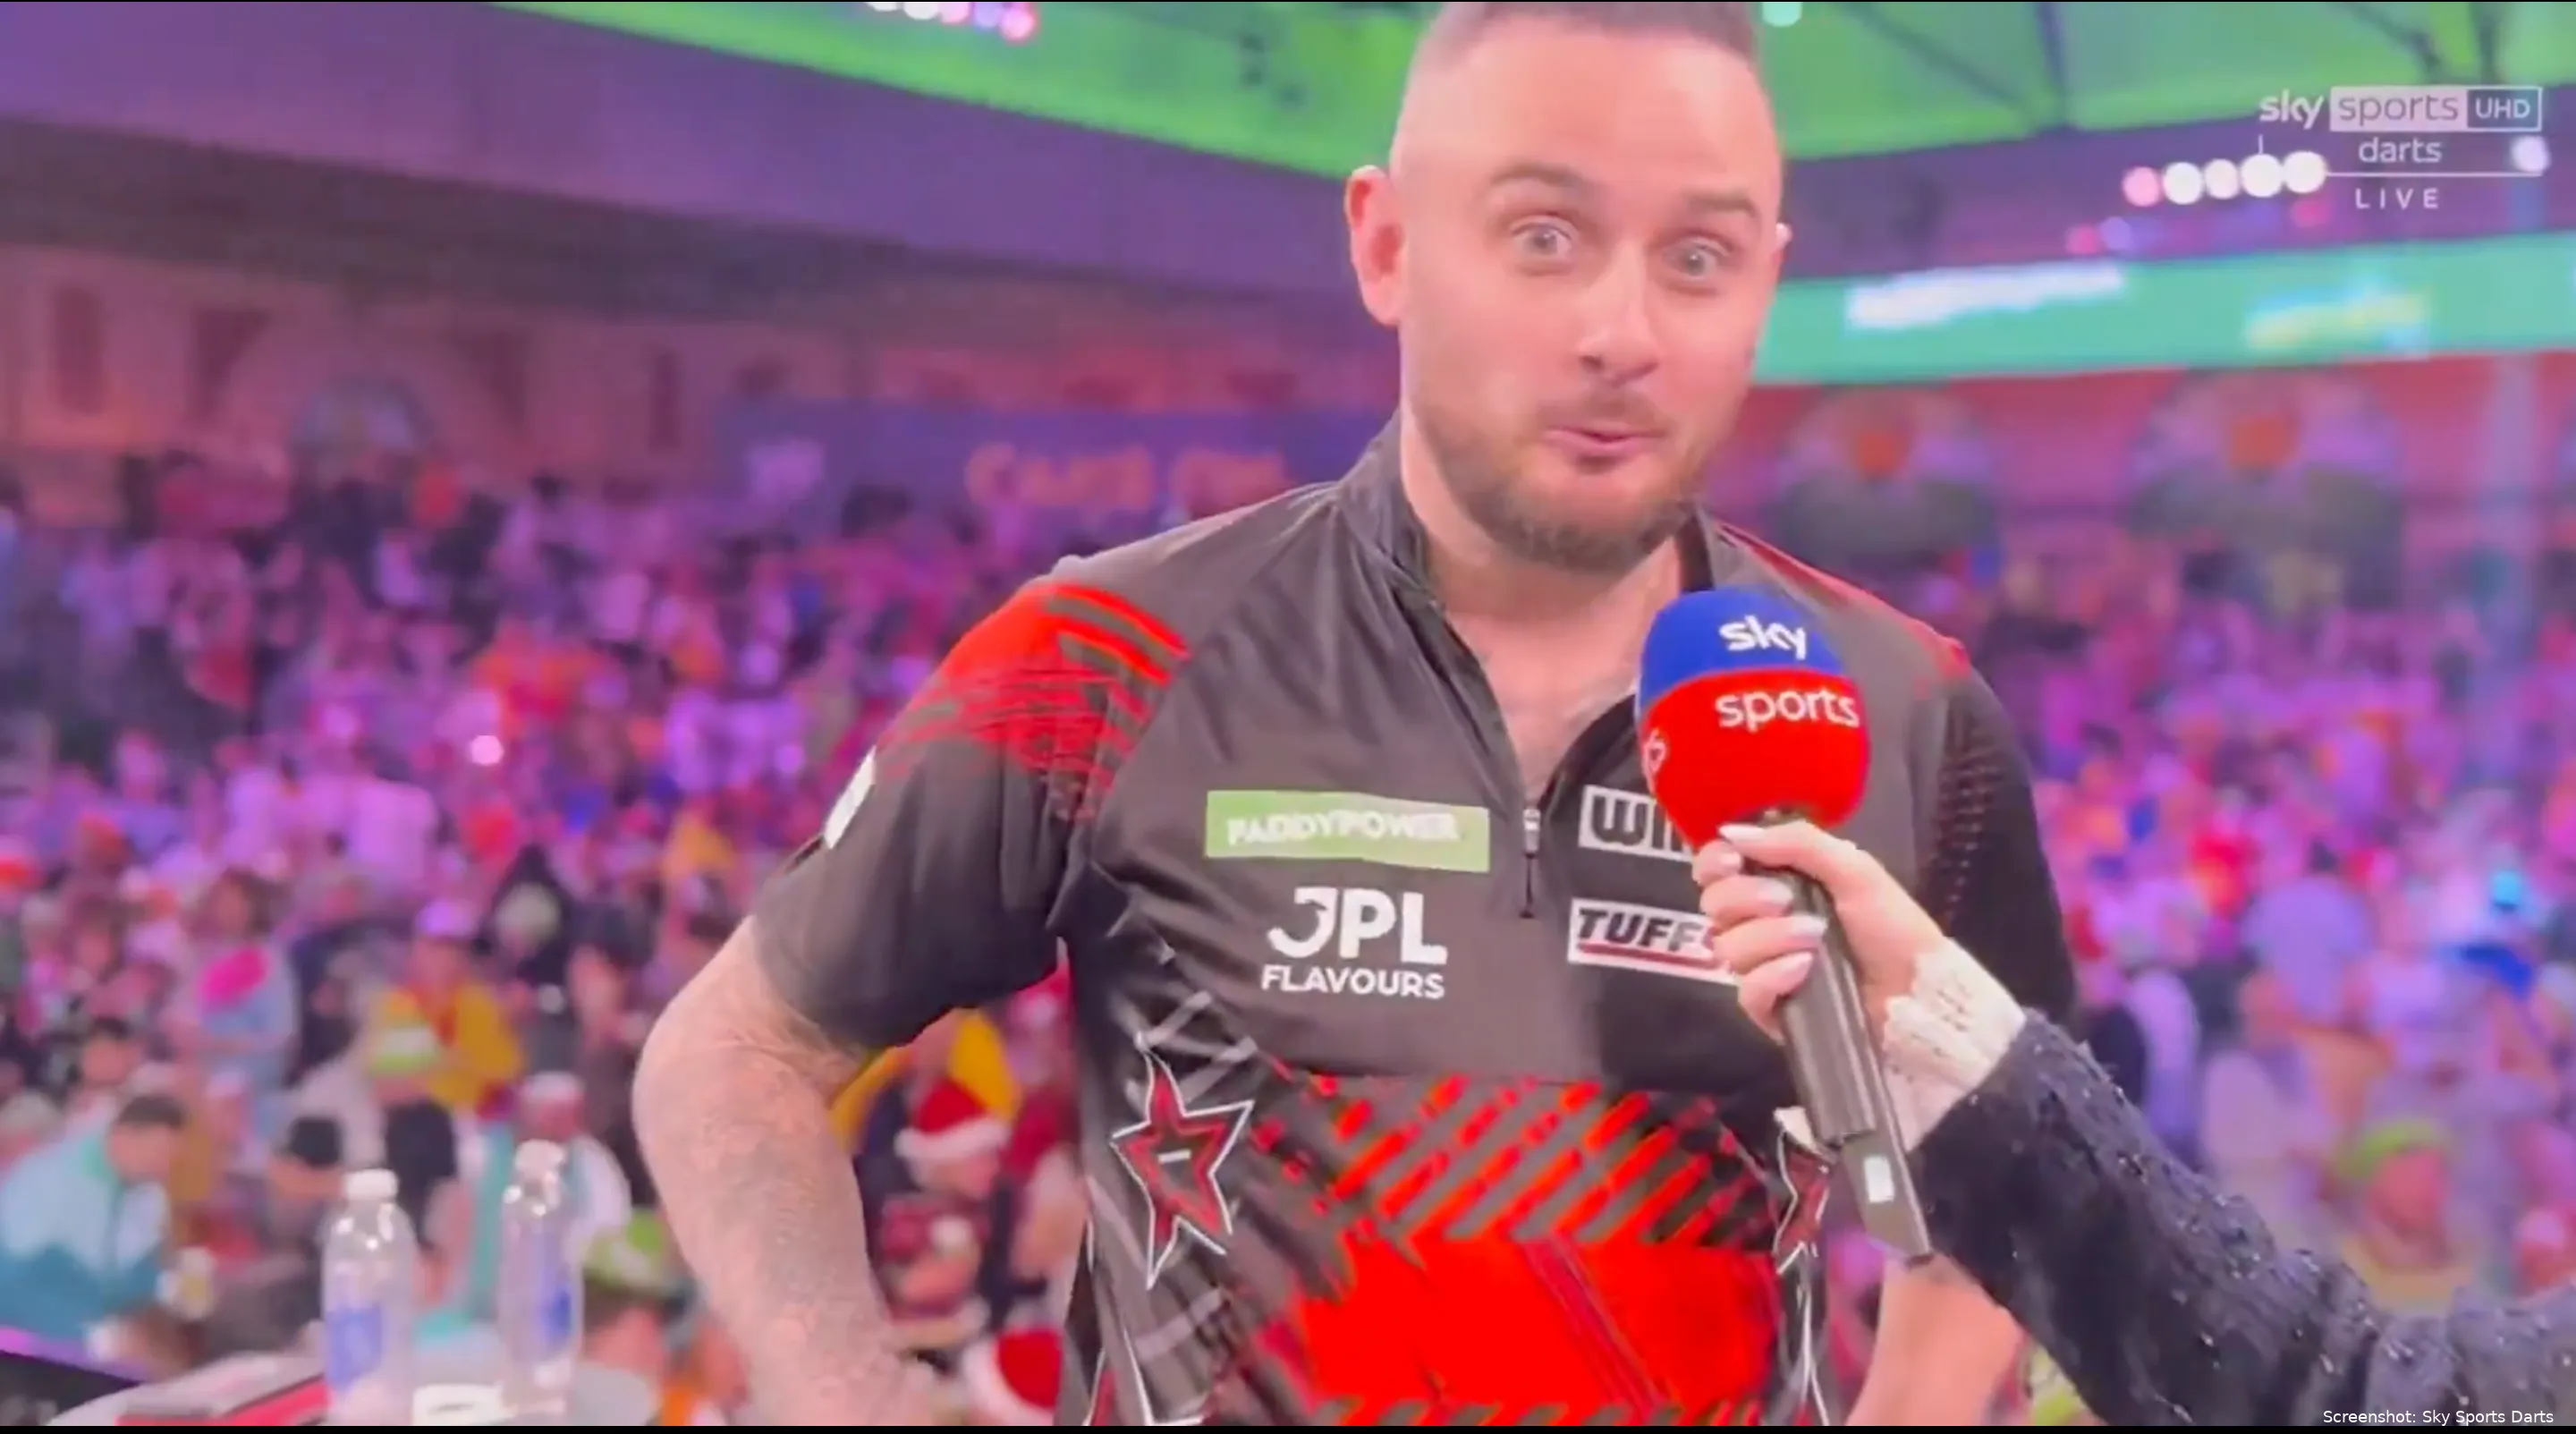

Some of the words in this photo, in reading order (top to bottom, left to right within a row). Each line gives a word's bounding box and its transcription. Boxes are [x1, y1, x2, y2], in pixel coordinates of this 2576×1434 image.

[1718, 615, 1807, 660] sky
[1715, 687, 1860, 734] sports
[1267, 886, 1448, 965] JPL
[1261, 963, 1445, 999] FLAVOURS
